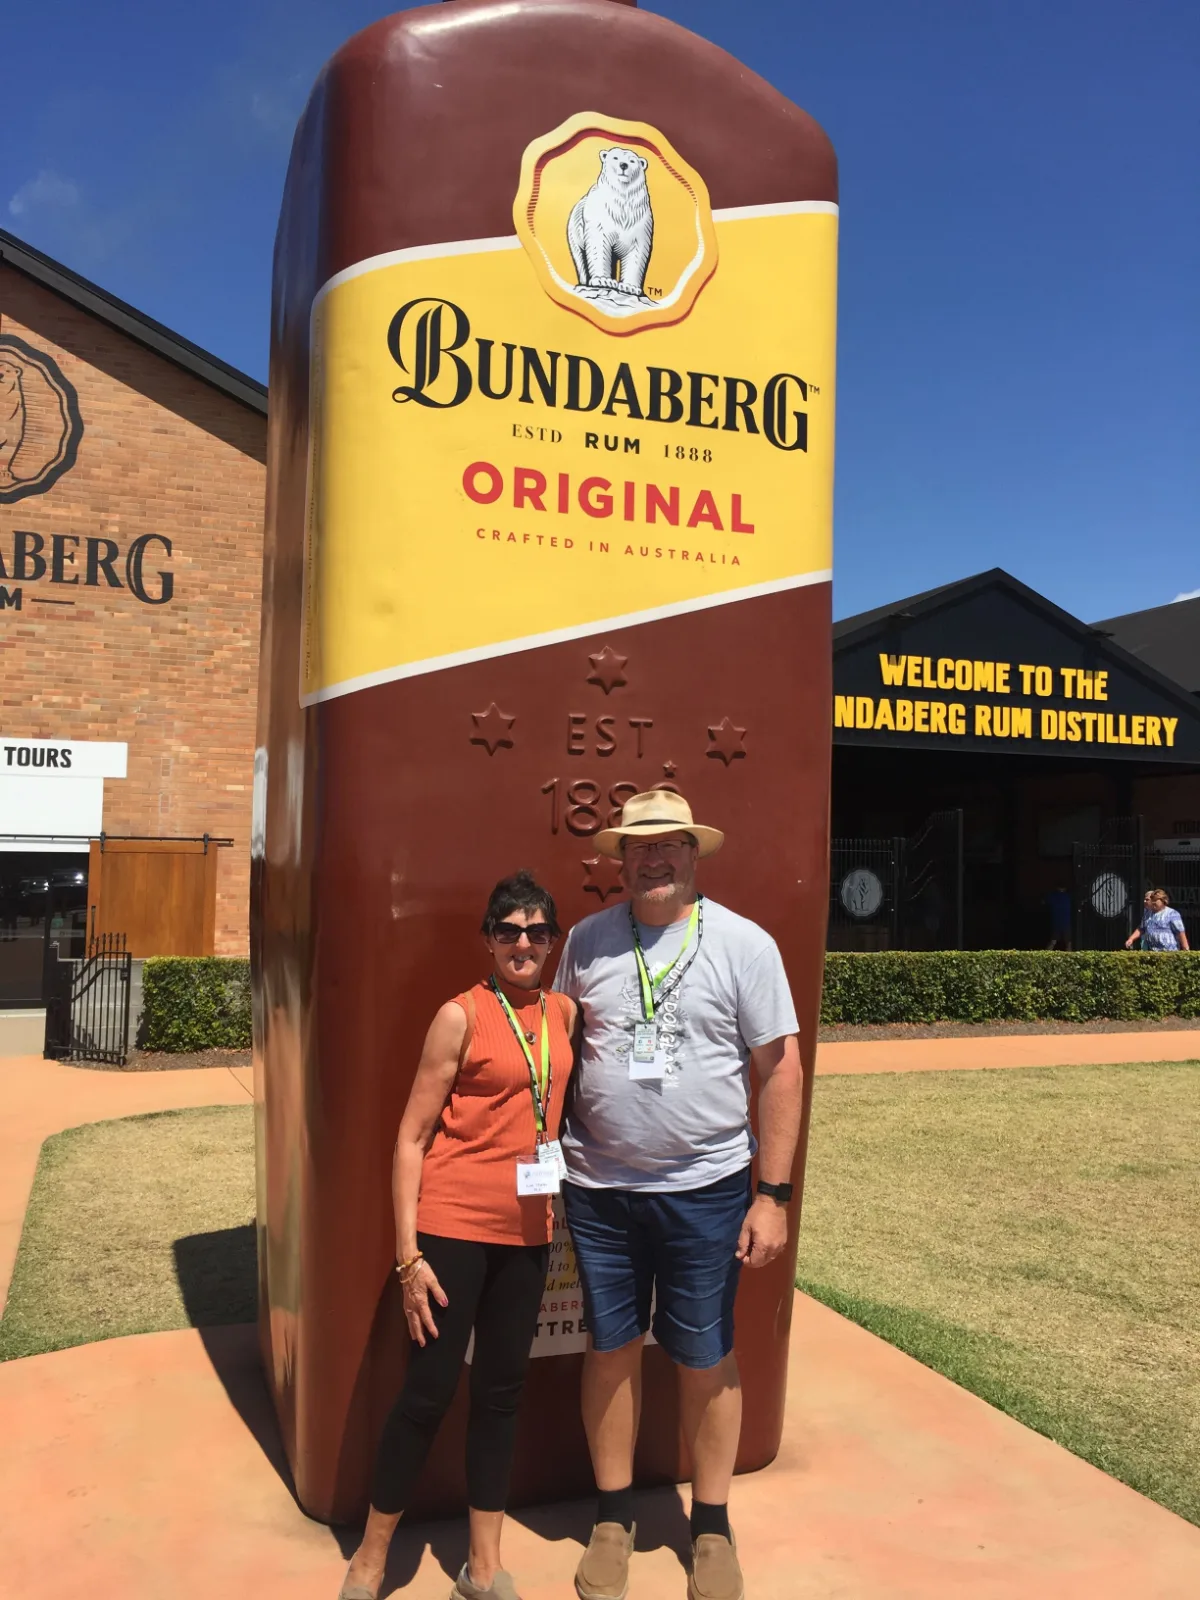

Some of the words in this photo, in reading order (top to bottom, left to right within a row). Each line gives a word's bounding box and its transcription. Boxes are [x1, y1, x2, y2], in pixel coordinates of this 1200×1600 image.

[387, 297, 808, 454] BUNDABERG
[511, 424, 563, 444] ESTD
[584, 432, 641, 455] RUM
[663, 444, 714, 463] 1888
[462, 461, 755, 534] ORIGINAL
[476, 528, 575, 549] CRAFTED
[589, 541, 610, 553] IN
[624, 545, 741, 566] AUSTRALIA
[879, 653, 1011, 694] WELCOME
[1019, 664, 1053, 697] TO
[1060, 667, 1109, 701] THE
[567, 713, 654, 758] EST
[834, 695, 966, 736] NDABERG
[974, 704, 1032, 739] RUM
[1041, 709, 1179, 747] DISTILLERY
[4, 746, 72, 768] TOURS
[540, 777, 682, 837] 188
[540, 1300, 584, 1313] ABER
